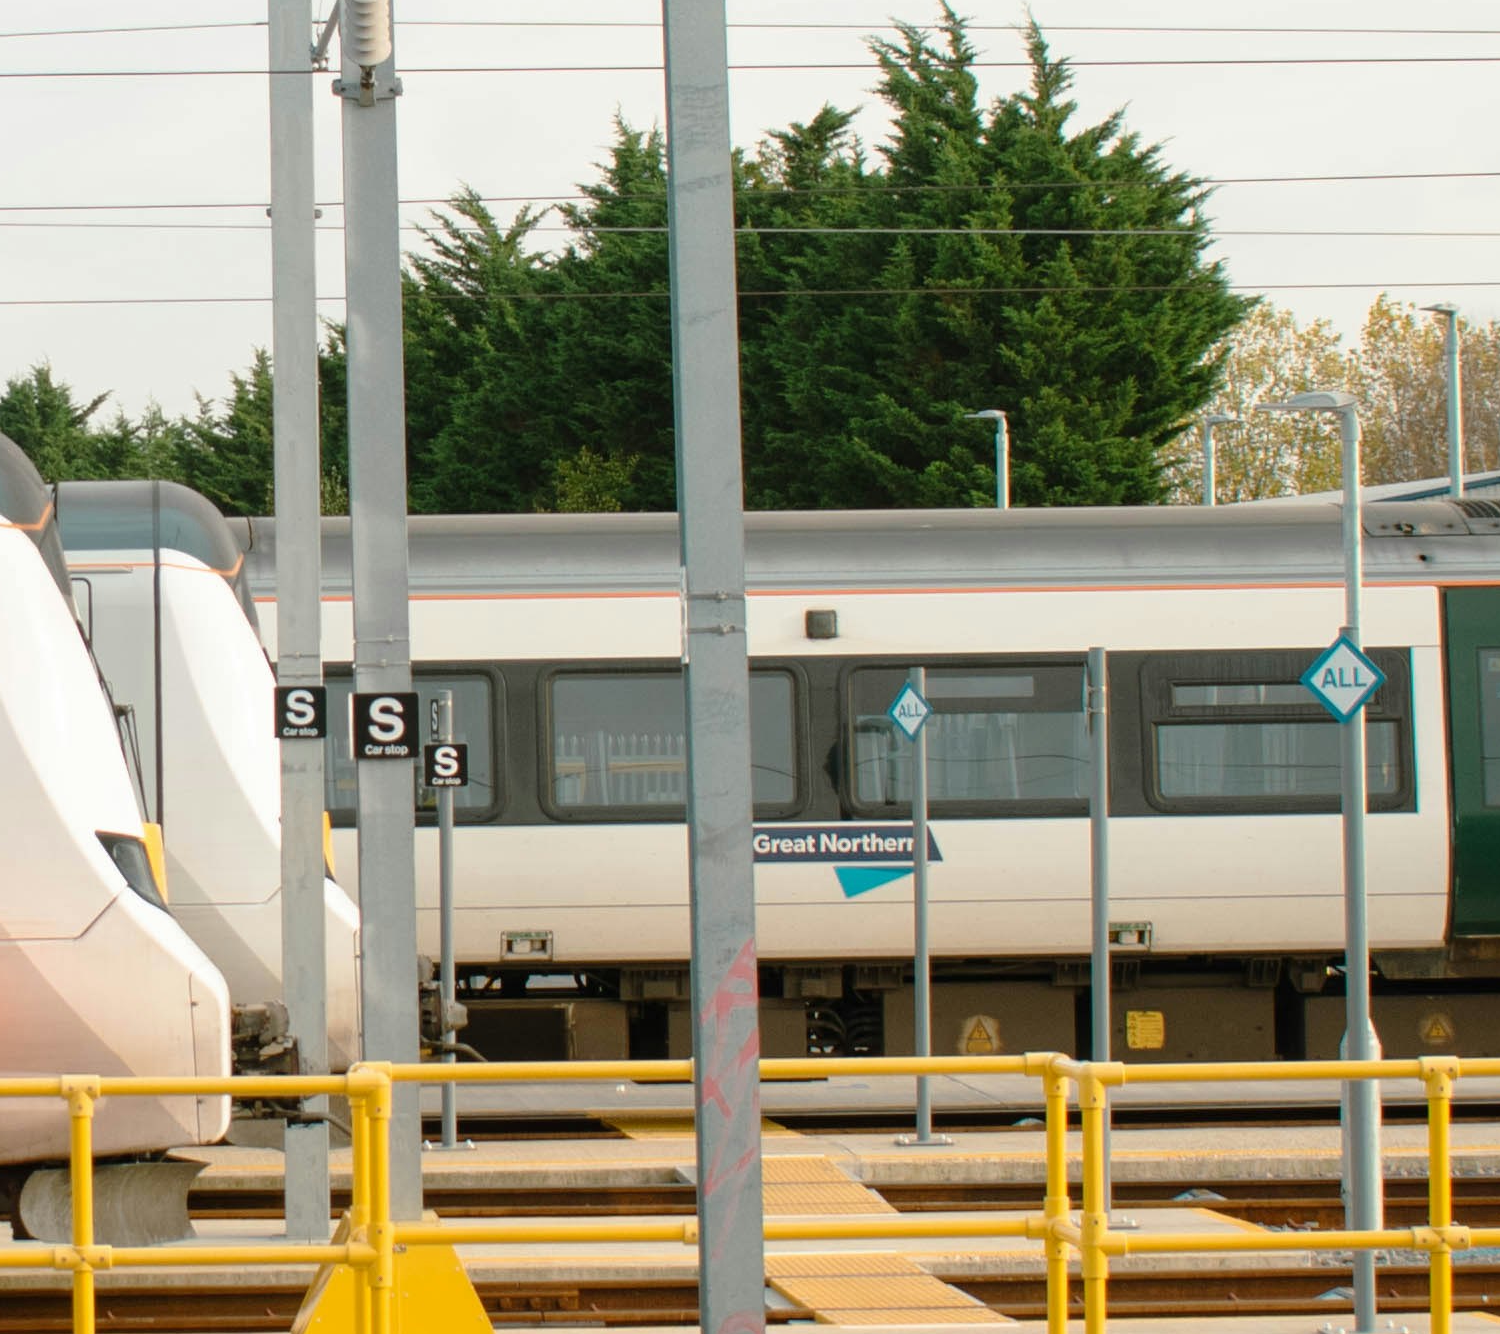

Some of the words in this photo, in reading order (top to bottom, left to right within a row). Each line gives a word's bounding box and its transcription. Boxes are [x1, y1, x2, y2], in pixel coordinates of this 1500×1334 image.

[1321, 666, 1367, 688] ALL
[286, 689, 316, 726] S
[899, 702, 922, 717] ALL
[368, 696, 405, 742] S
[283, 727, 298, 737] Car
[299, 727, 318, 738] stop
[365, 744, 383, 755] Car
[385, 743, 408, 756] stop
[434, 746, 459, 776] S
[432, 777, 444, 785] Car
[445, 777, 461, 786] stop
[753, 834, 816, 854] Great
